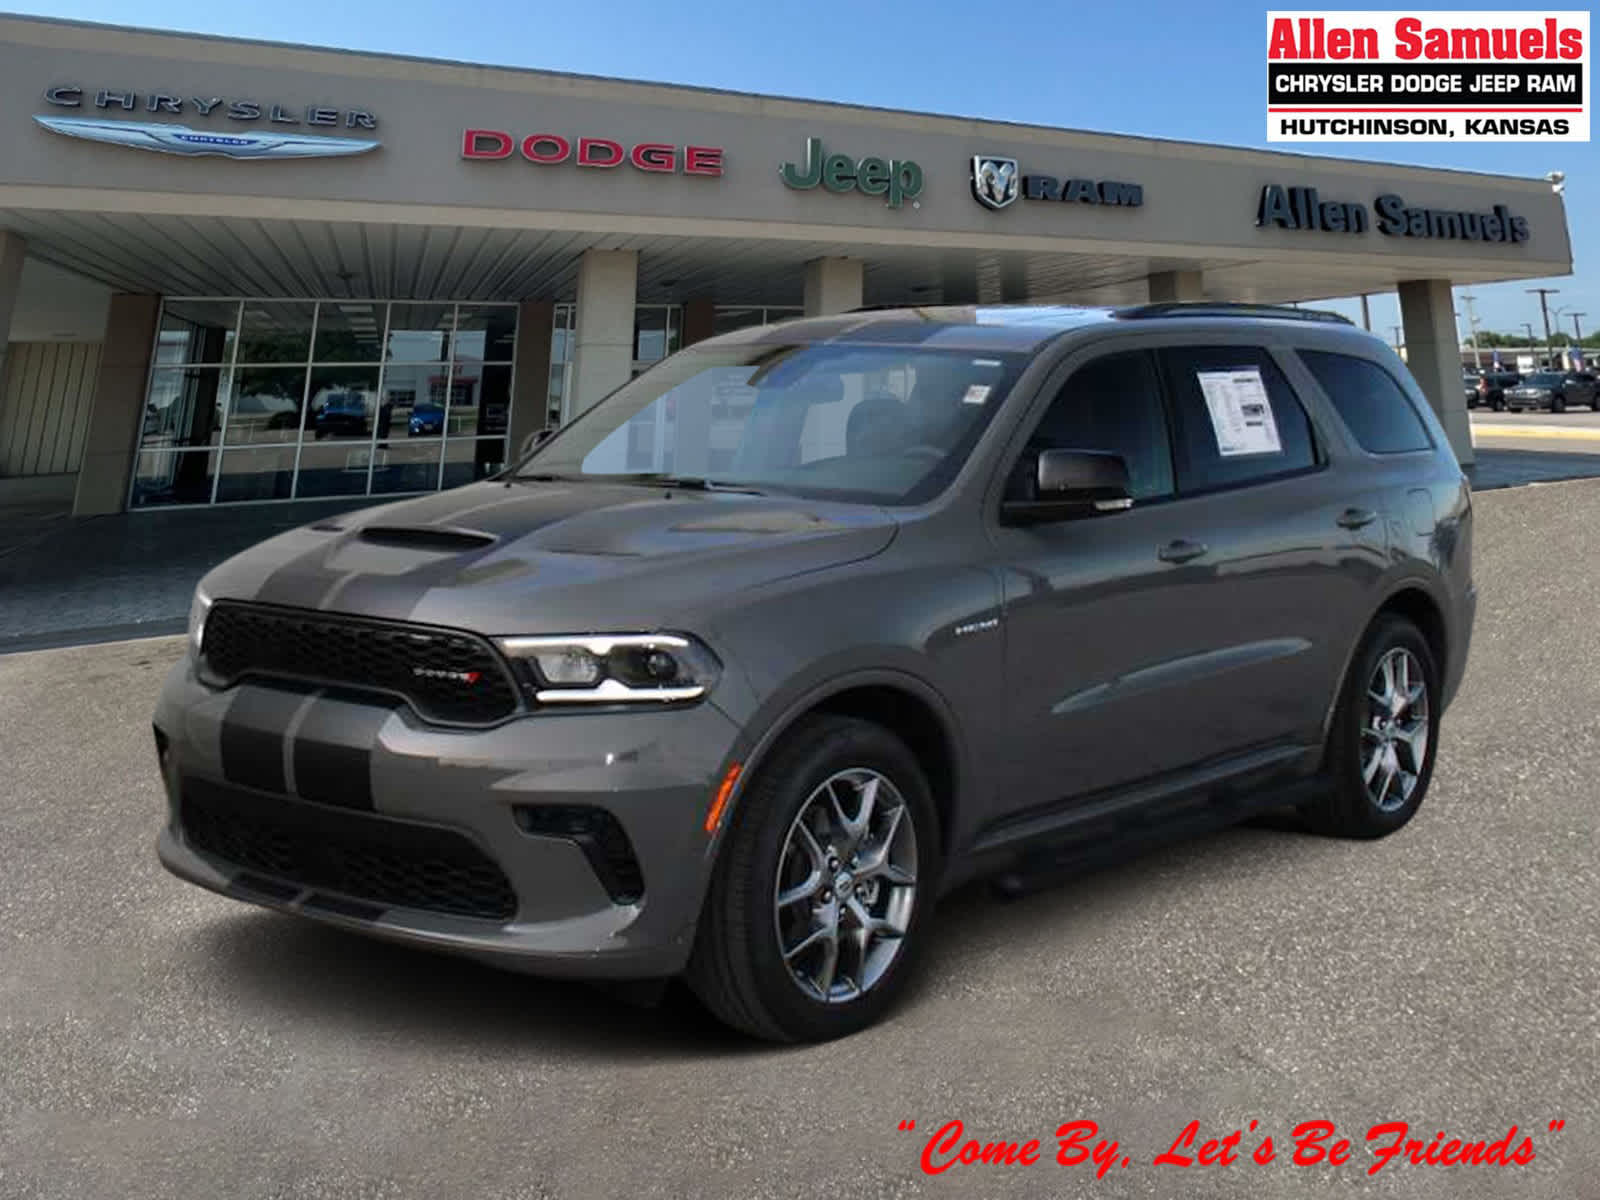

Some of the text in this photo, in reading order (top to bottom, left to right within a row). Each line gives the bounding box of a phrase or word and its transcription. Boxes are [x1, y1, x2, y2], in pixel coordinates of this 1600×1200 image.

[45, 86, 379, 129] CHRYSLER
[462, 127, 724, 175] DODGE
[779, 137, 923, 209] Jeep
[1022, 174, 1144, 207] RAM
[1255, 184, 1530, 243] Allen Samuels
